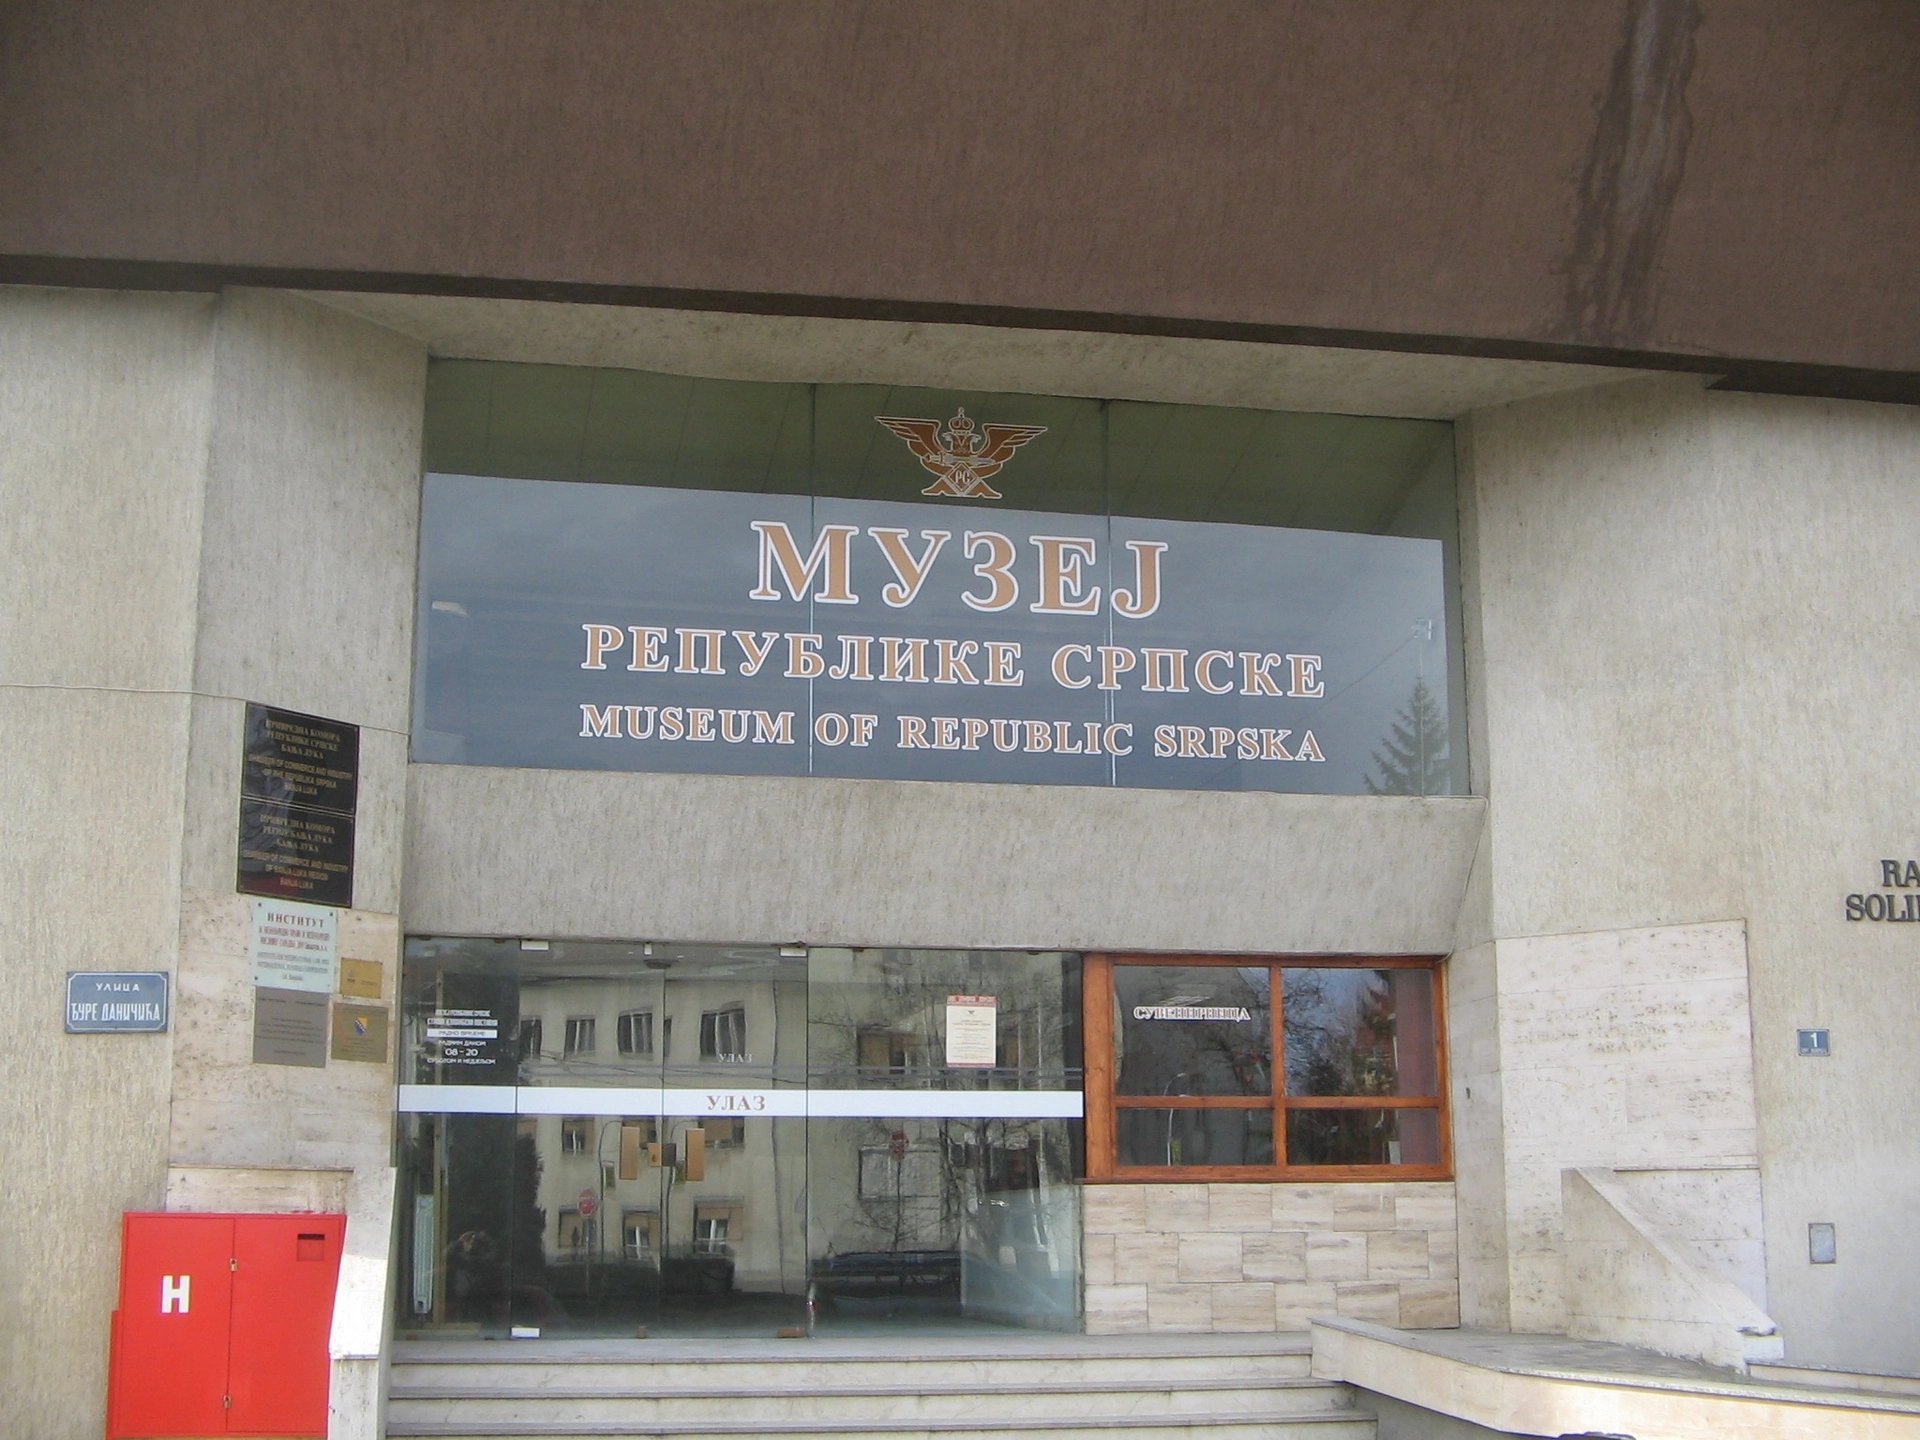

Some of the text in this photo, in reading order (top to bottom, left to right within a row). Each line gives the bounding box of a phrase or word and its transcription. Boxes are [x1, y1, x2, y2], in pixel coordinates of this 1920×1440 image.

[749, 520, 1169, 619] МУЗЕЈ
[581, 623, 1326, 699] РЕПУБЛИКЕ СРПСКЕ
[580, 704, 1326, 763] MUSEUM OF REPUBLIC SRPSKA
[1880, 859, 1920, 888] RA
[267, 911, 325, 928] ИНСТИТУТ
[95, 982, 140, 993] УЛИЦА
[71, 1002, 160, 1022] ЂУРЕ ДАНИЧИЋА
[1133, 1006, 1251, 1022] СУВЕНИРНИЦА
[1810, 1032, 1818, 1048] 1
[444, 1048, 459, 1056] 08
[465, 1048, 479, 1057] 20
[718, 1053, 753, 1063] УЛАЗ
[706, 1095, 765, 1111] УЛАЗ
[161, 1275, 191, 1314] H
